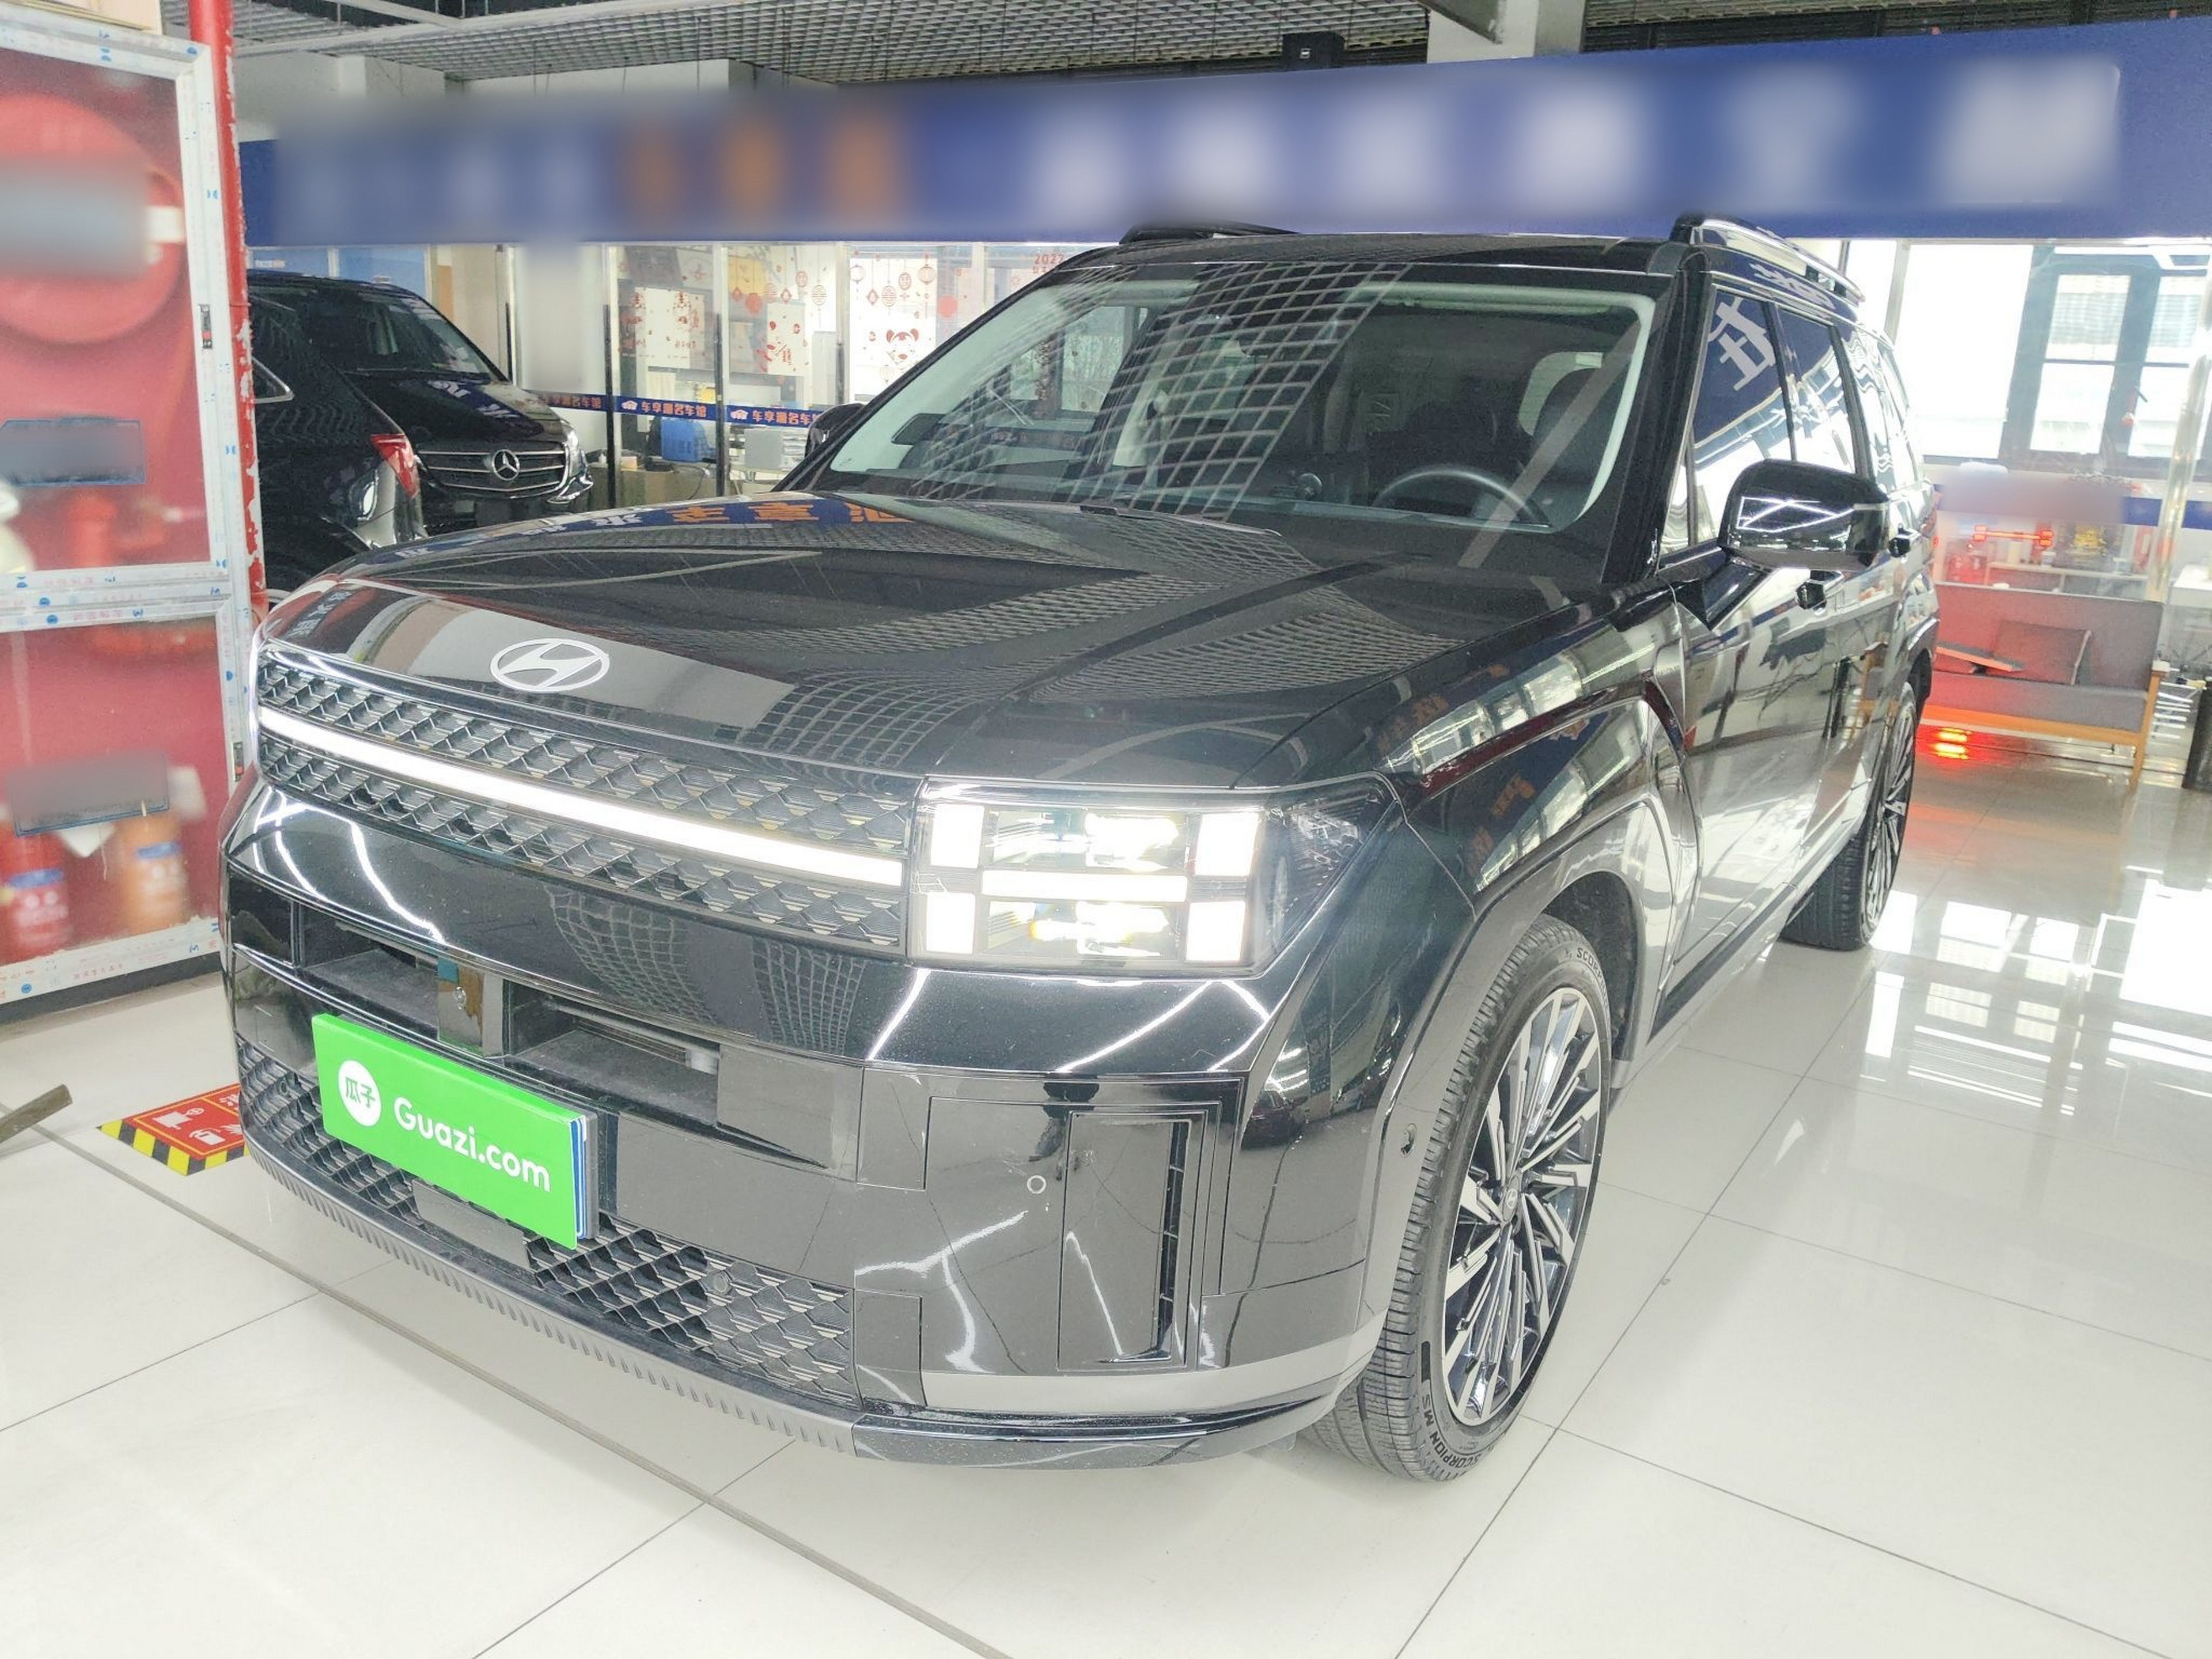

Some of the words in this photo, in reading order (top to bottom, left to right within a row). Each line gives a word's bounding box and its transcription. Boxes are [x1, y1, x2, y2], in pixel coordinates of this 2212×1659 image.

[346, 1077, 376, 1108] 瓜子
[393, 1097, 551, 1192] Guazi.com
[1429, 1431, 1482, 1469] SCORPION
